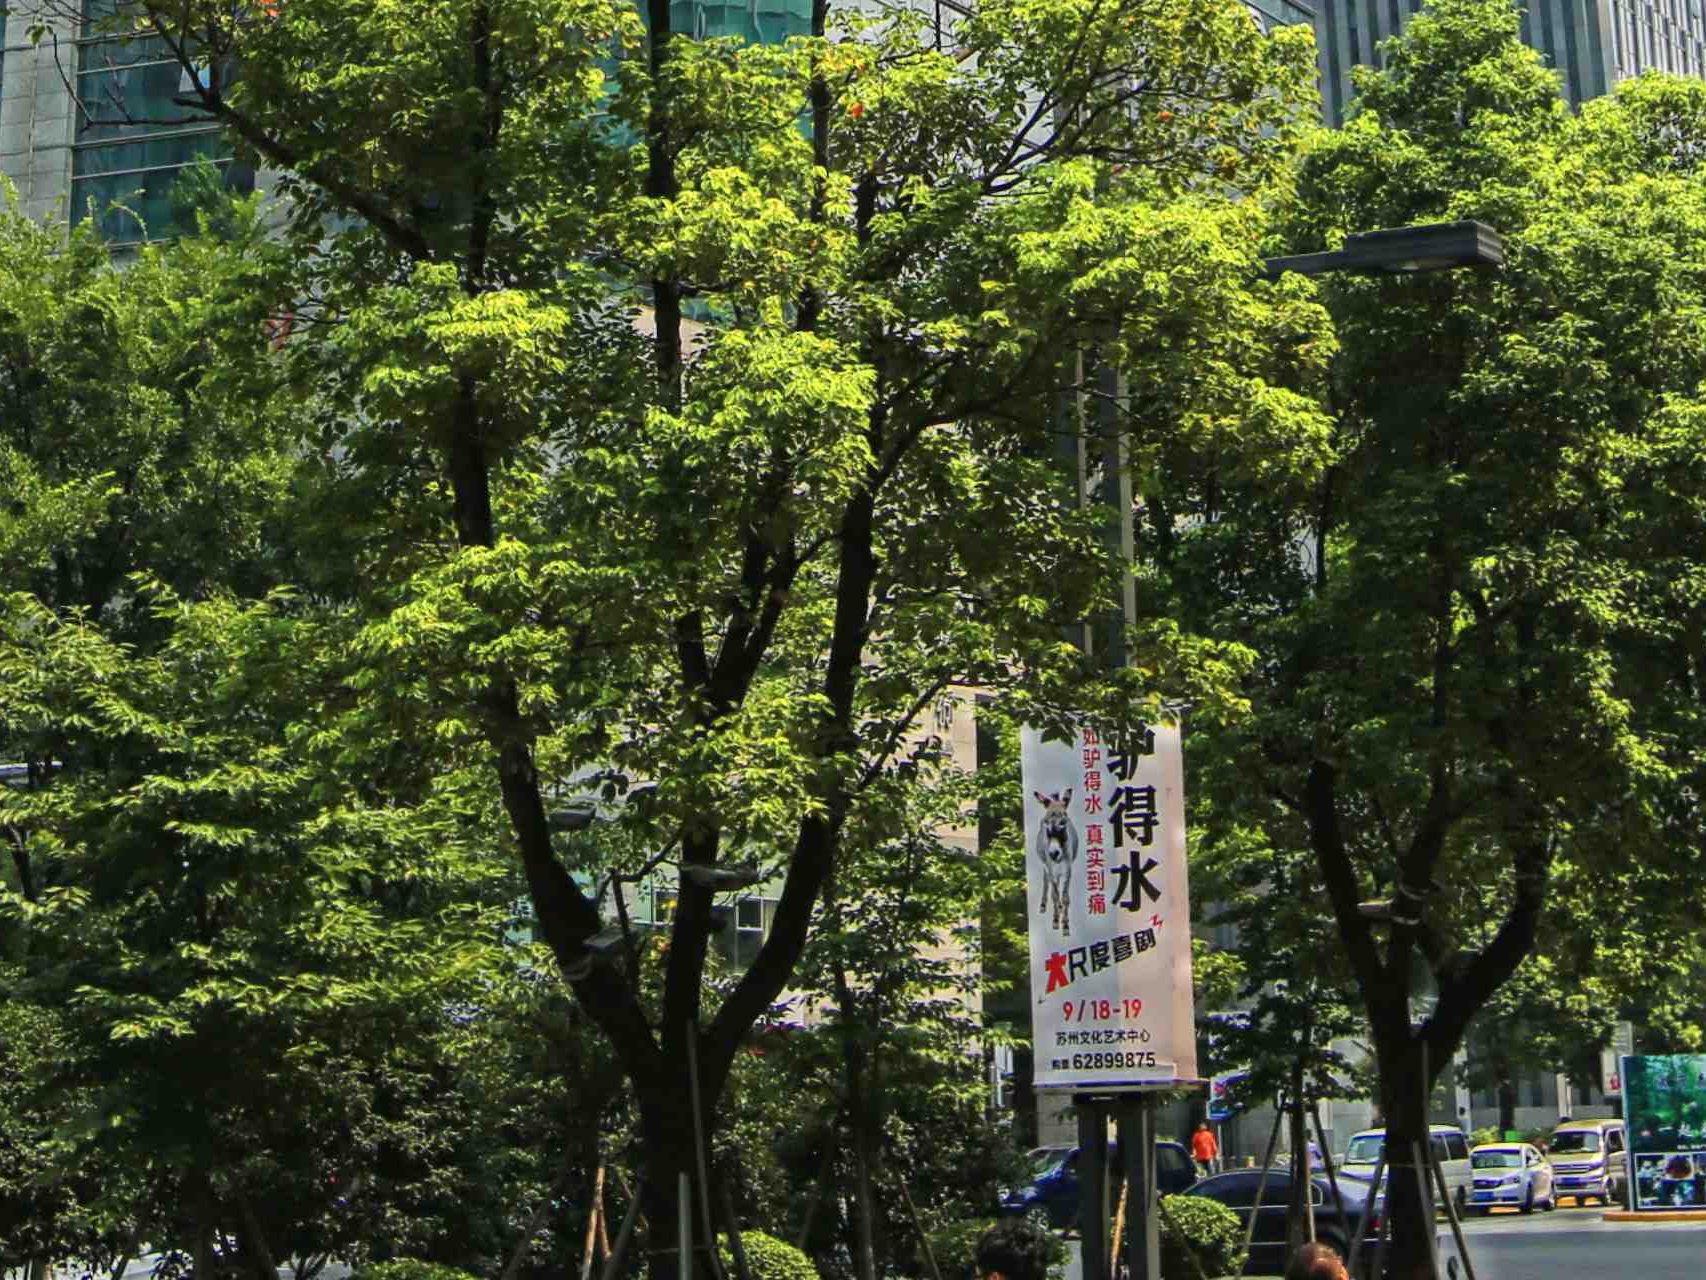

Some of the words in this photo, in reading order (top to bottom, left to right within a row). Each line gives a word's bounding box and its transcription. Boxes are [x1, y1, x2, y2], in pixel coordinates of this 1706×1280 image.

[1085, 824, 1106, 915] 真实到痛
[1045, 928, 1156, 994] 大尺度喜剧
[1056, 1028, 1151, 1046] 苏州文化艺术中心
[1073, 1051, 1156, 1070] 62899875
